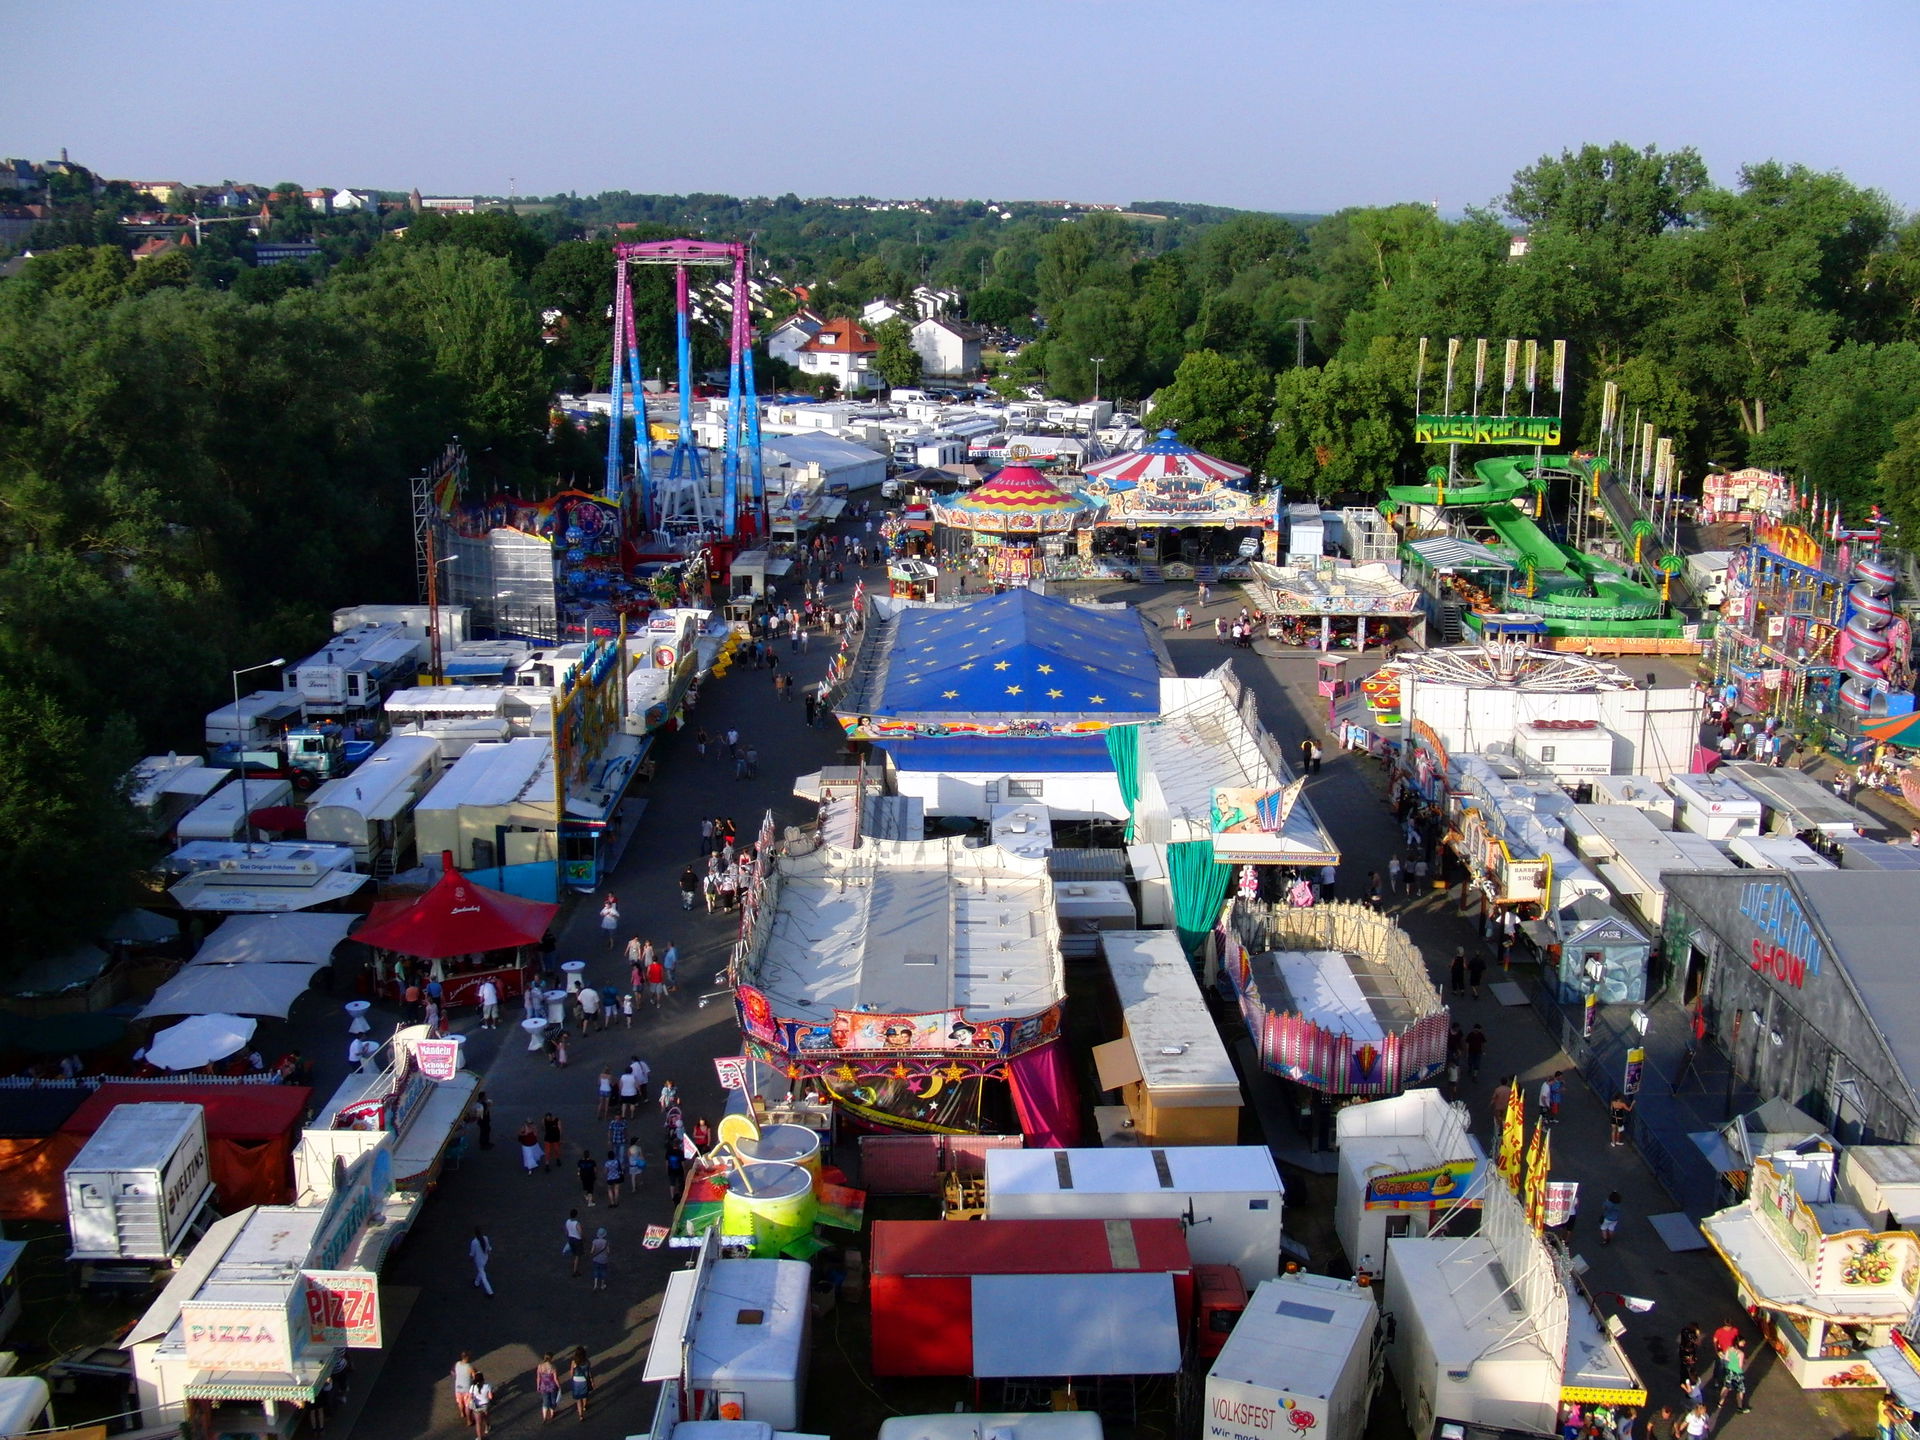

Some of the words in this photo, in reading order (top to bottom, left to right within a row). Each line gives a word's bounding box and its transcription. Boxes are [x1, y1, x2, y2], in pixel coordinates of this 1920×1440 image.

[1416, 415, 1474, 443] RIVER
[1475, 416, 1562, 446] RAFTING
[1599, 930, 1621, 939] KASSE
[1750, 938, 1806, 990] SHOW
[420, 1045, 452, 1056] Mandeln
[174, 1145, 204, 1203] VELTINS
[306, 1290, 376, 1329] PIZZA
[191, 1324, 275, 1343] PIZZA
[1212, 1397, 1277, 1431] VOLKSFEST
[1211, 1425, 1231, 1438] Wir
